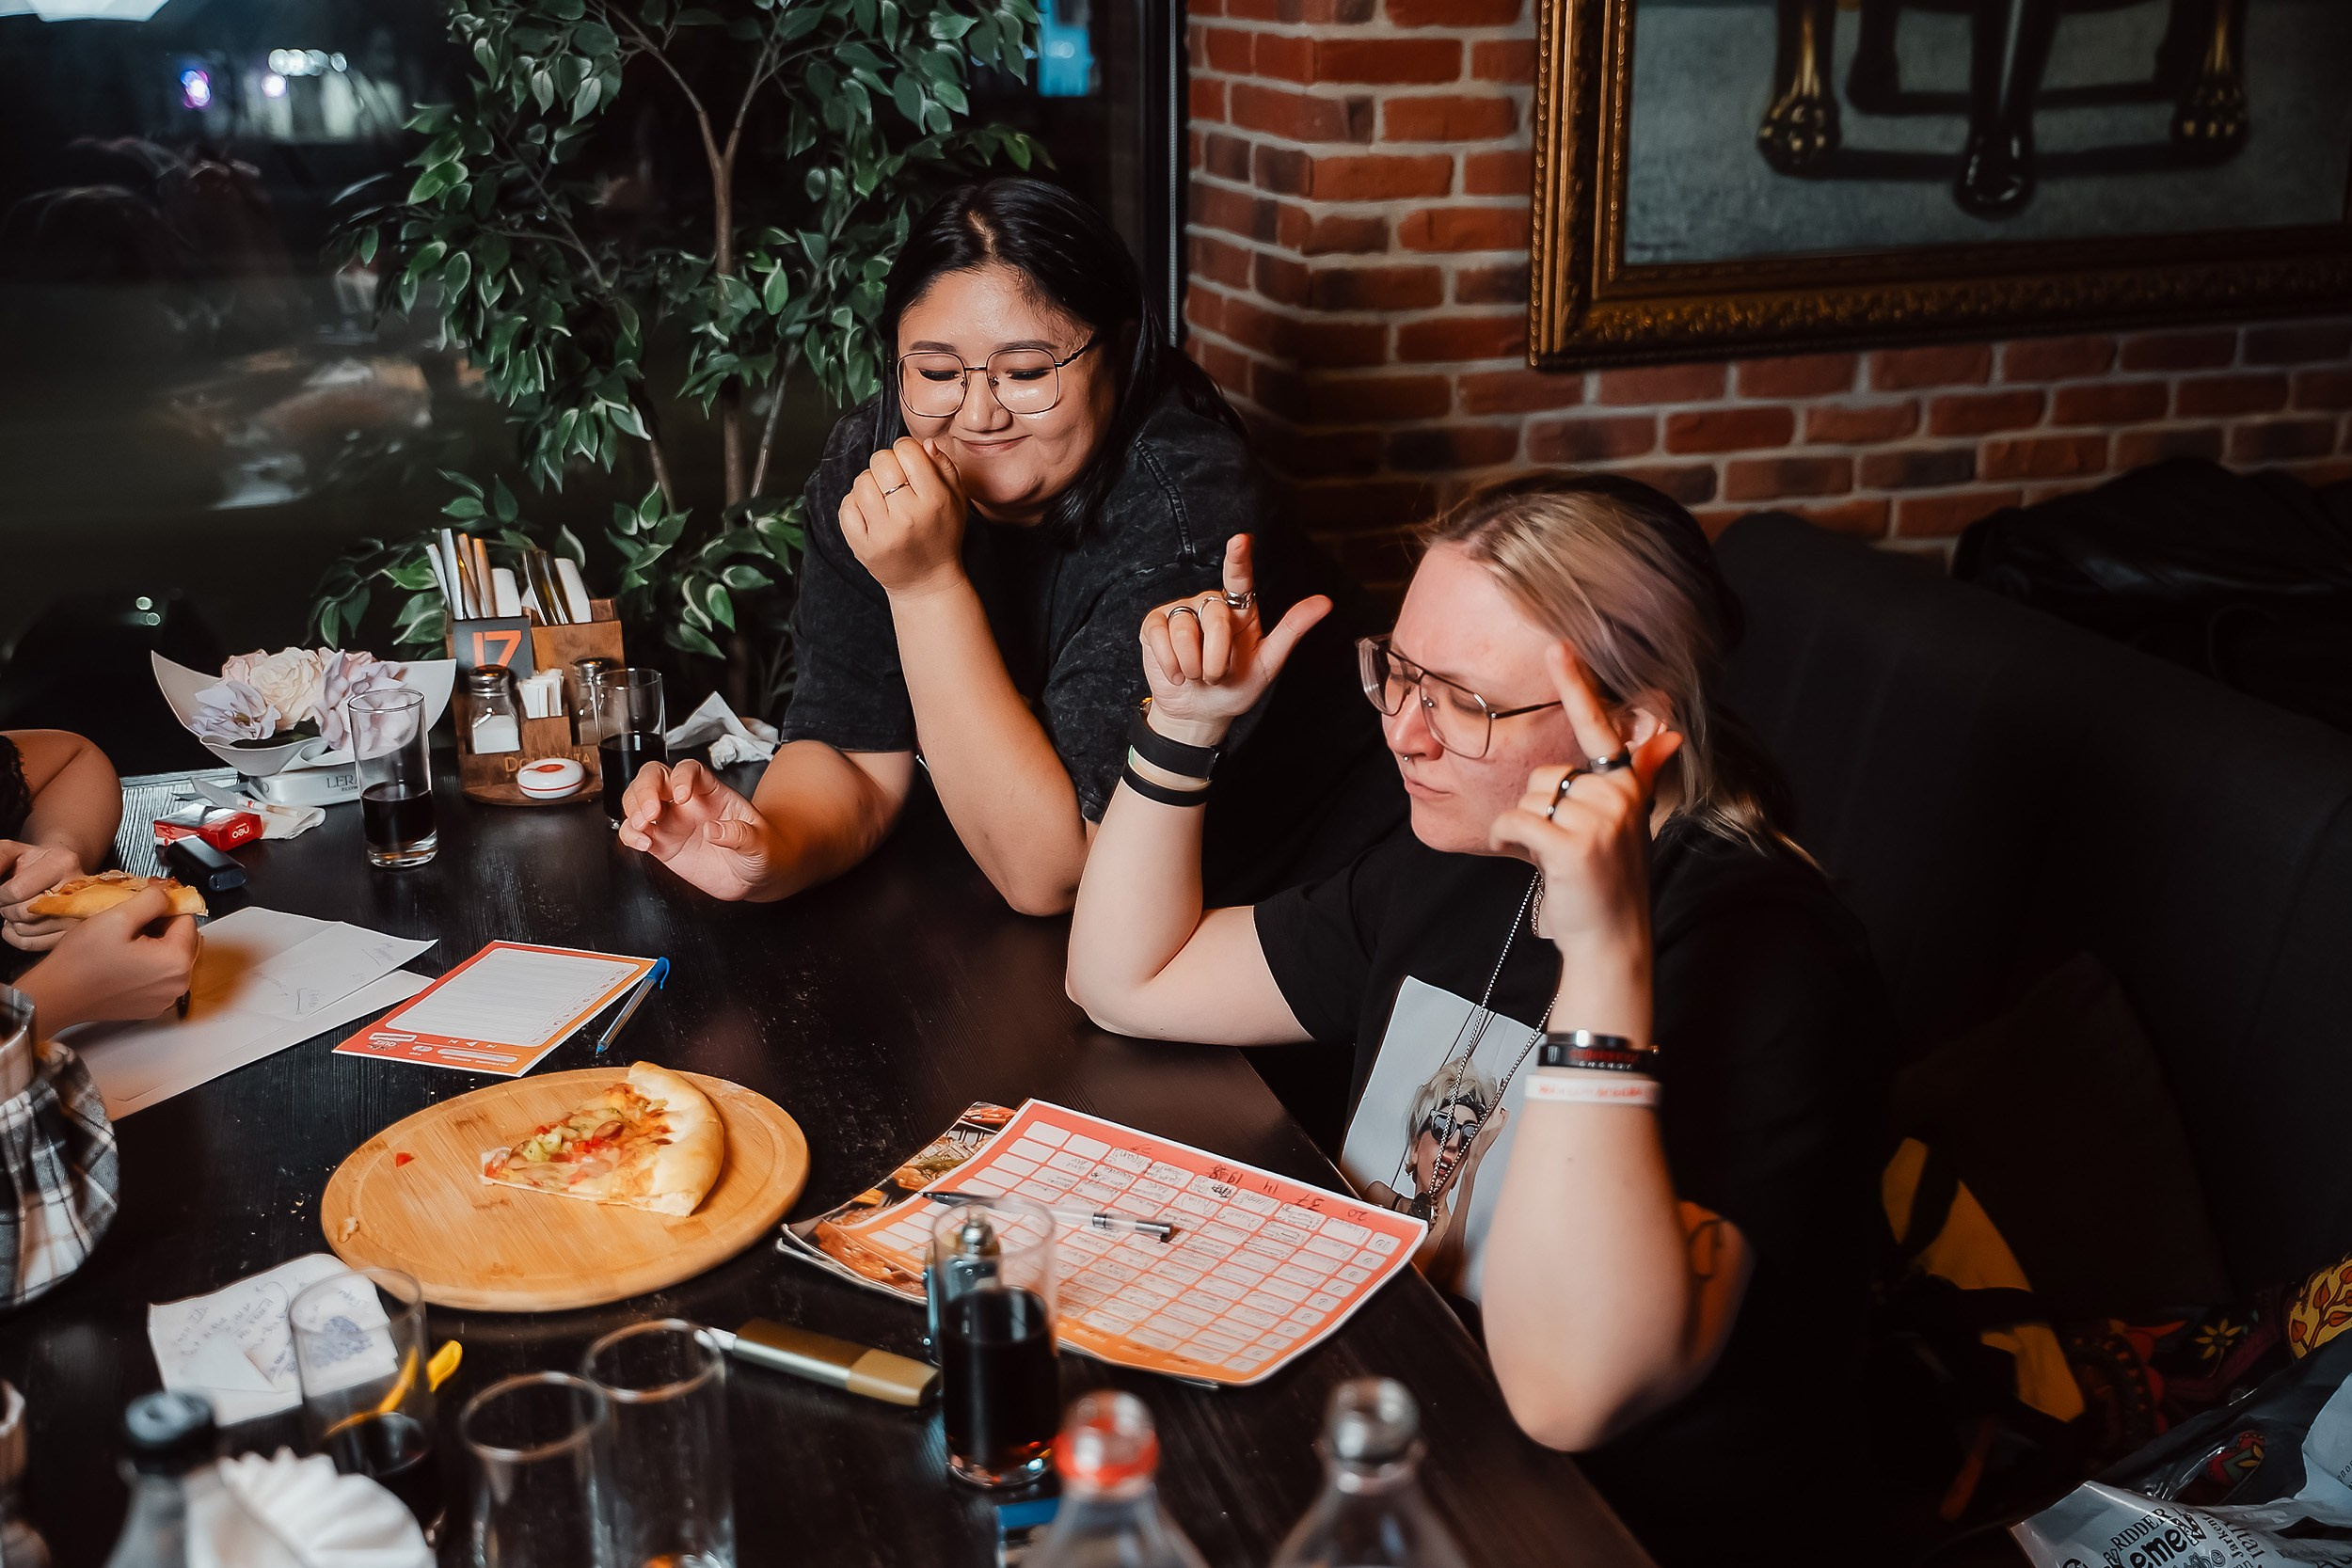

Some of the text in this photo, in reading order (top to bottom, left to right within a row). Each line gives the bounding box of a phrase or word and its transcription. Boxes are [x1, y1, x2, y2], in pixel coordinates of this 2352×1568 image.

[473, 629, 522, 668] 17
[231, 822, 250, 839] neo
[1294, 1194, 1325, 1213] 37
[1346, 1208, 1369, 1222] 20
[2110, 1508, 2171, 1552] RIDDER
